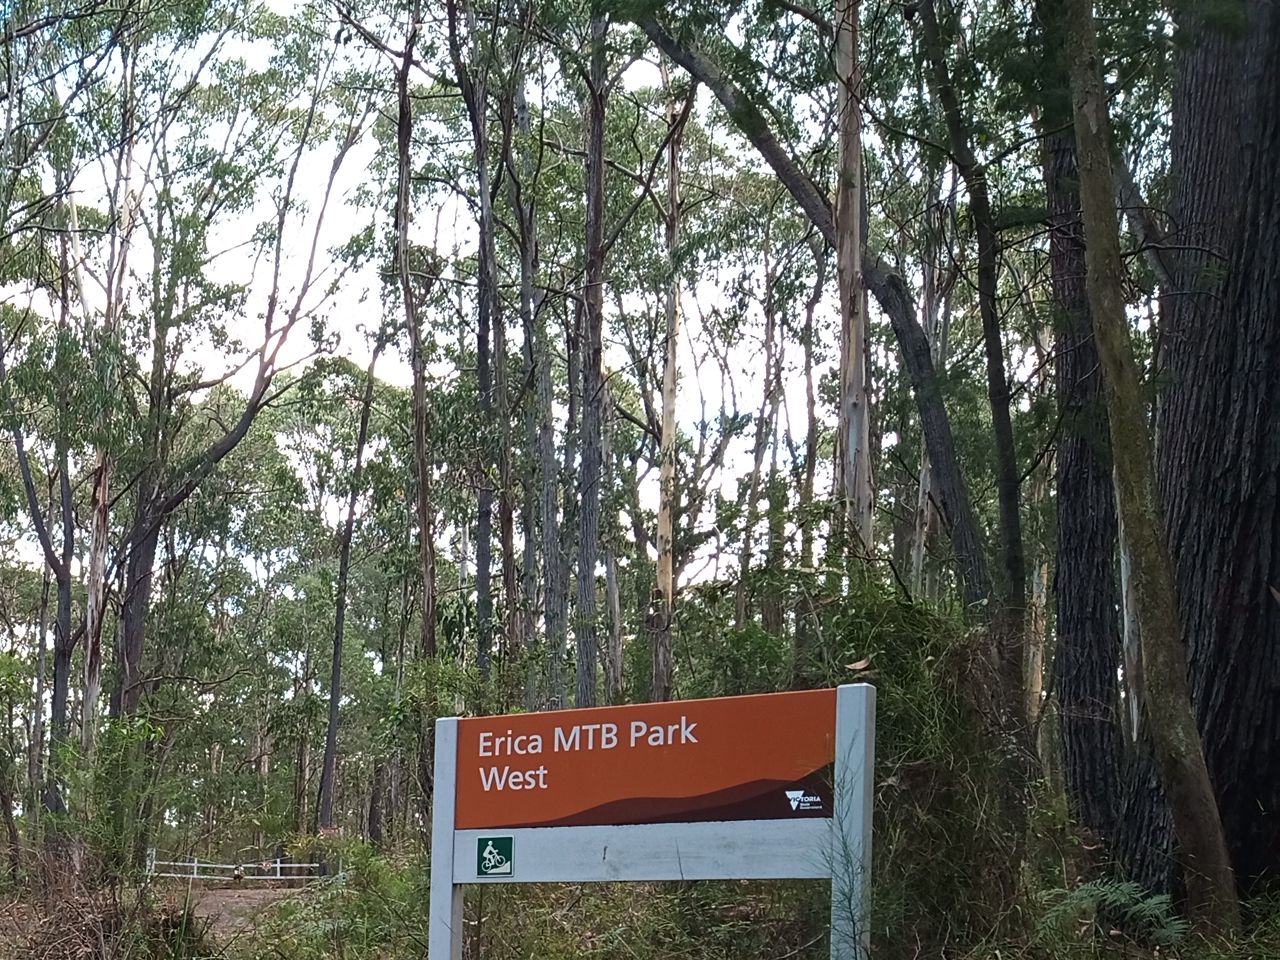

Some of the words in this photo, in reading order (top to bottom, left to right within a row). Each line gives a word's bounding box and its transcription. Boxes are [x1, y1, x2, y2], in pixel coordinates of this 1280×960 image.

[478, 729, 543, 757] Erica
[554, 723, 618, 752] MTB
[629, 716, 699, 747] Park
[478, 765, 548, 791] West
